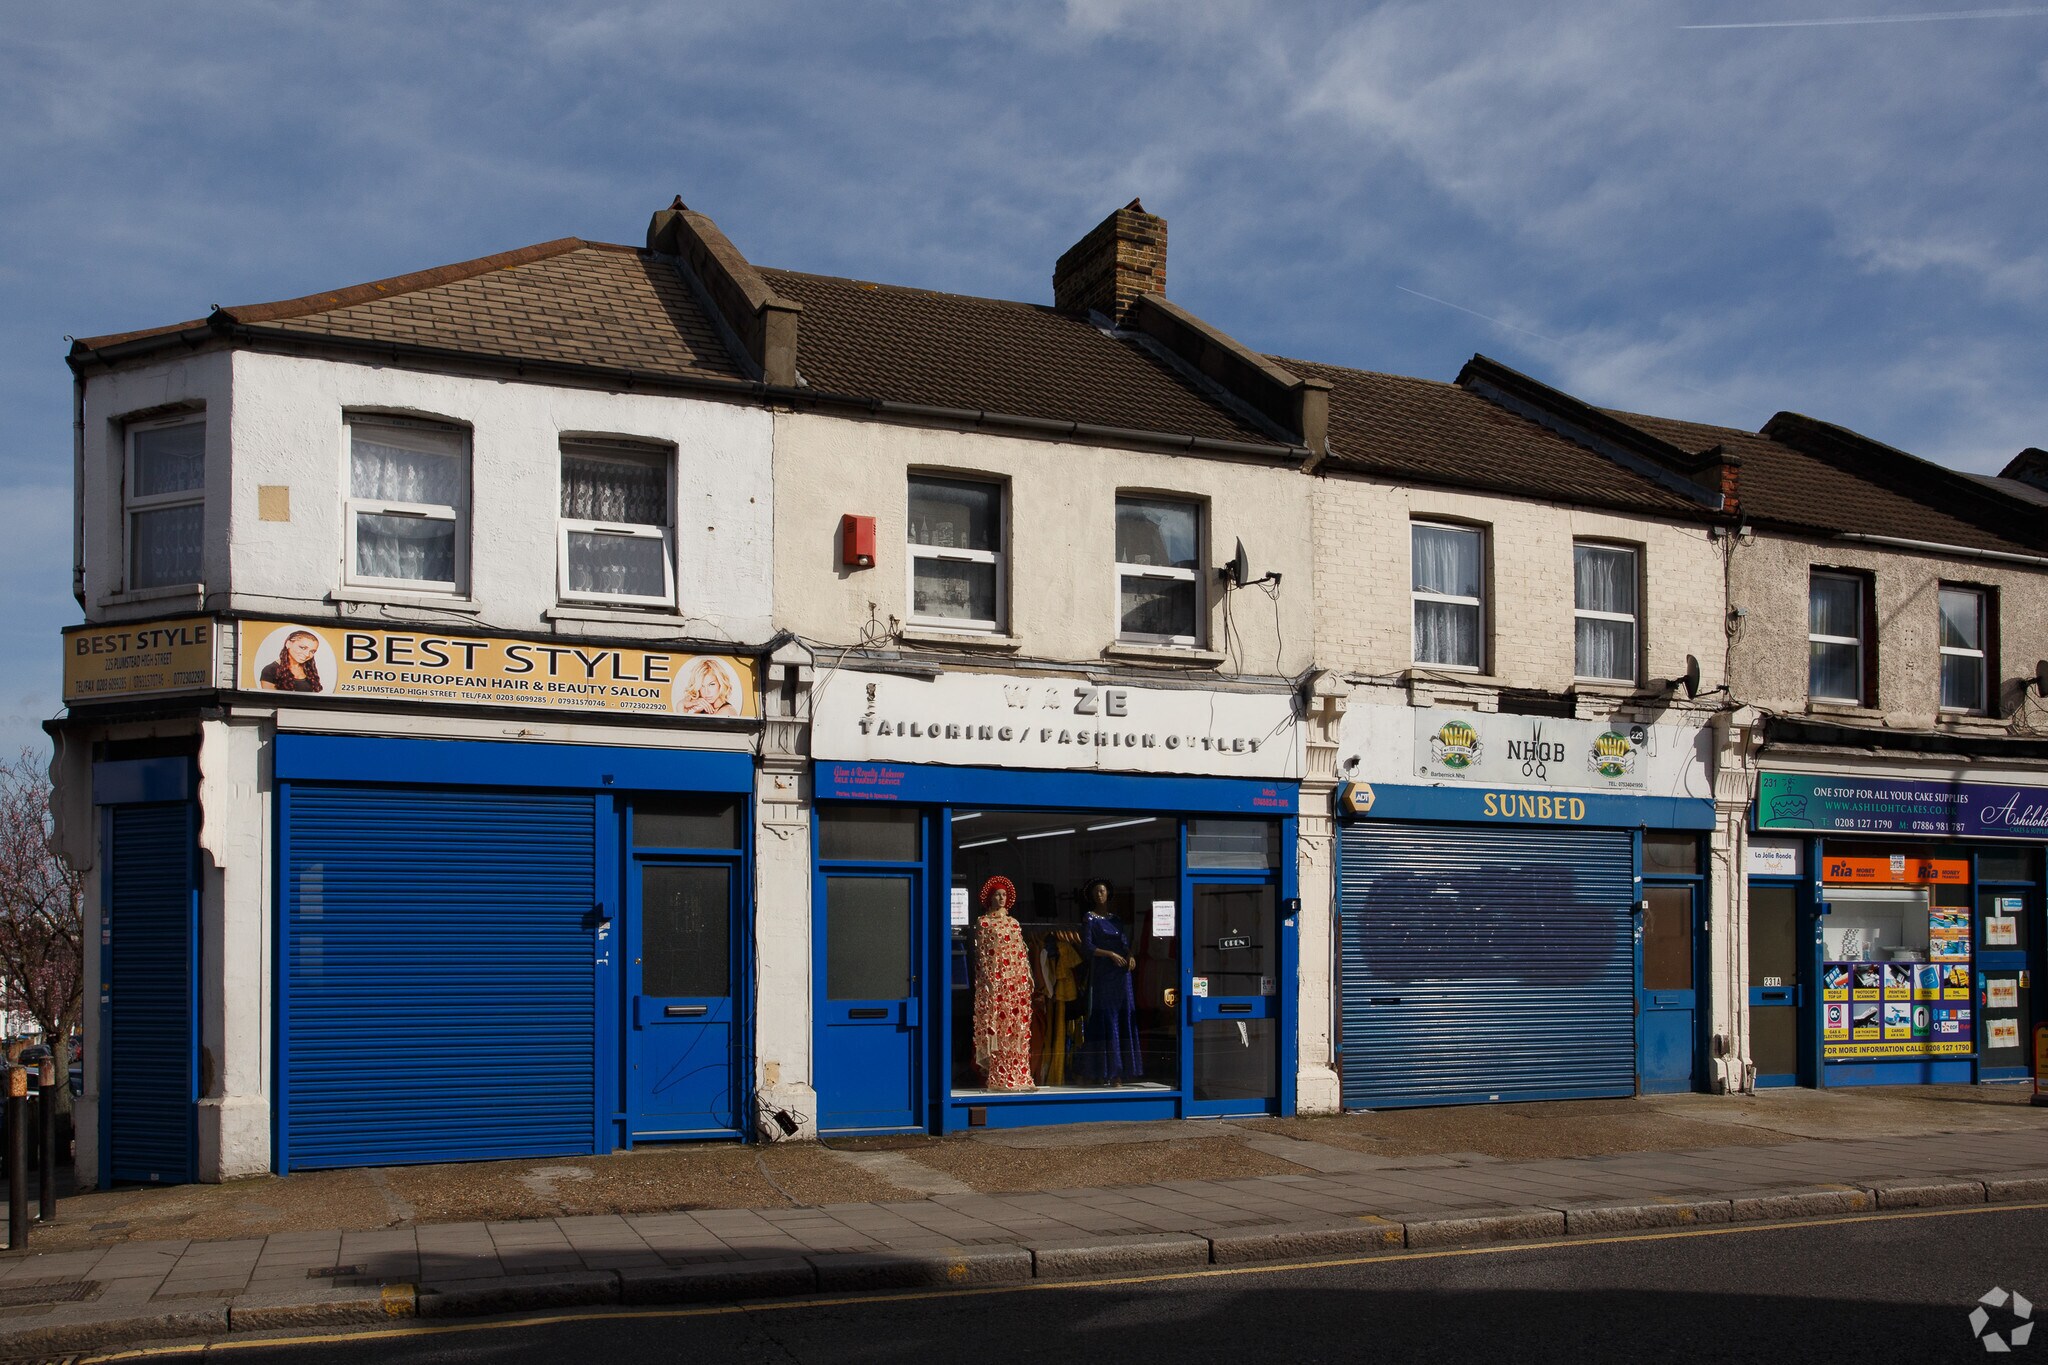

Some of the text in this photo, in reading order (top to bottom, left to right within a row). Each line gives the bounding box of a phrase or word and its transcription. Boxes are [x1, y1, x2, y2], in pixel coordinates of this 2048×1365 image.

[76, 626, 207, 656] BEST STYLE
[114, 655, 140, 670] PLUMSTEAD
[154, 652, 172, 666] STREET
[345, 633, 670, 682] BEST STYLE
[352, 669, 660, 698] AFRO EUROPEAN HAIR & BEAUTY SALON
[357, 685, 405, 695] PLUMSTEAD
[407, 688, 428, 696] HIGH
[461, 692, 492, 700] TEL/FAX
[516, 695, 547, 703] 6099285
[558, 698, 606, 707] 07931570746
[620, 702, 667, 710] 07723022920
[1040, 728, 1156, 748] FASHION
[1444, 728, 1472, 747] NHQ
[1631, 731, 1643, 740] 229
[1507, 740, 1565, 762] NHQB
[1600, 738, 1625, 756] NHQ
[1764, 778, 1777, 788] 231
[1356, 793, 1370, 802] ADT
[1814, 787, 1969, 803] ONE STOP FOR ALL YOUR CAKE SUPPLIES
[1484, 792, 1585, 821] SUNBED
[1825, 801, 1957, 815] WWW.ASHILOHTCAKES.CO.UK
[1835, 818, 1854, 827] 0208
[1857, 819, 1871, 828] 127
[1874, 820, 1892, 829] 1790
[1899, 821, 1908, 829] M:
[1912, 821, 1934, 830] 07886
[1935, 822, 1949, 831] 981
[1952, 823, 1965, 831] 787
[1831, 860, 1852, 877] Ria
[1918, 863, 1938, 878] Ria
[1224, 939, 1245, 947] OPEN
[1764, 977, 1781, 986] 231A
[1824, 1047, 1837, 1055] FOR
[1838, 1046, 1858, 1054] MORE
[1859, 1045, 1904, 1053] INFORMATION
[1925, 1044, 1941, 1052] 0208
